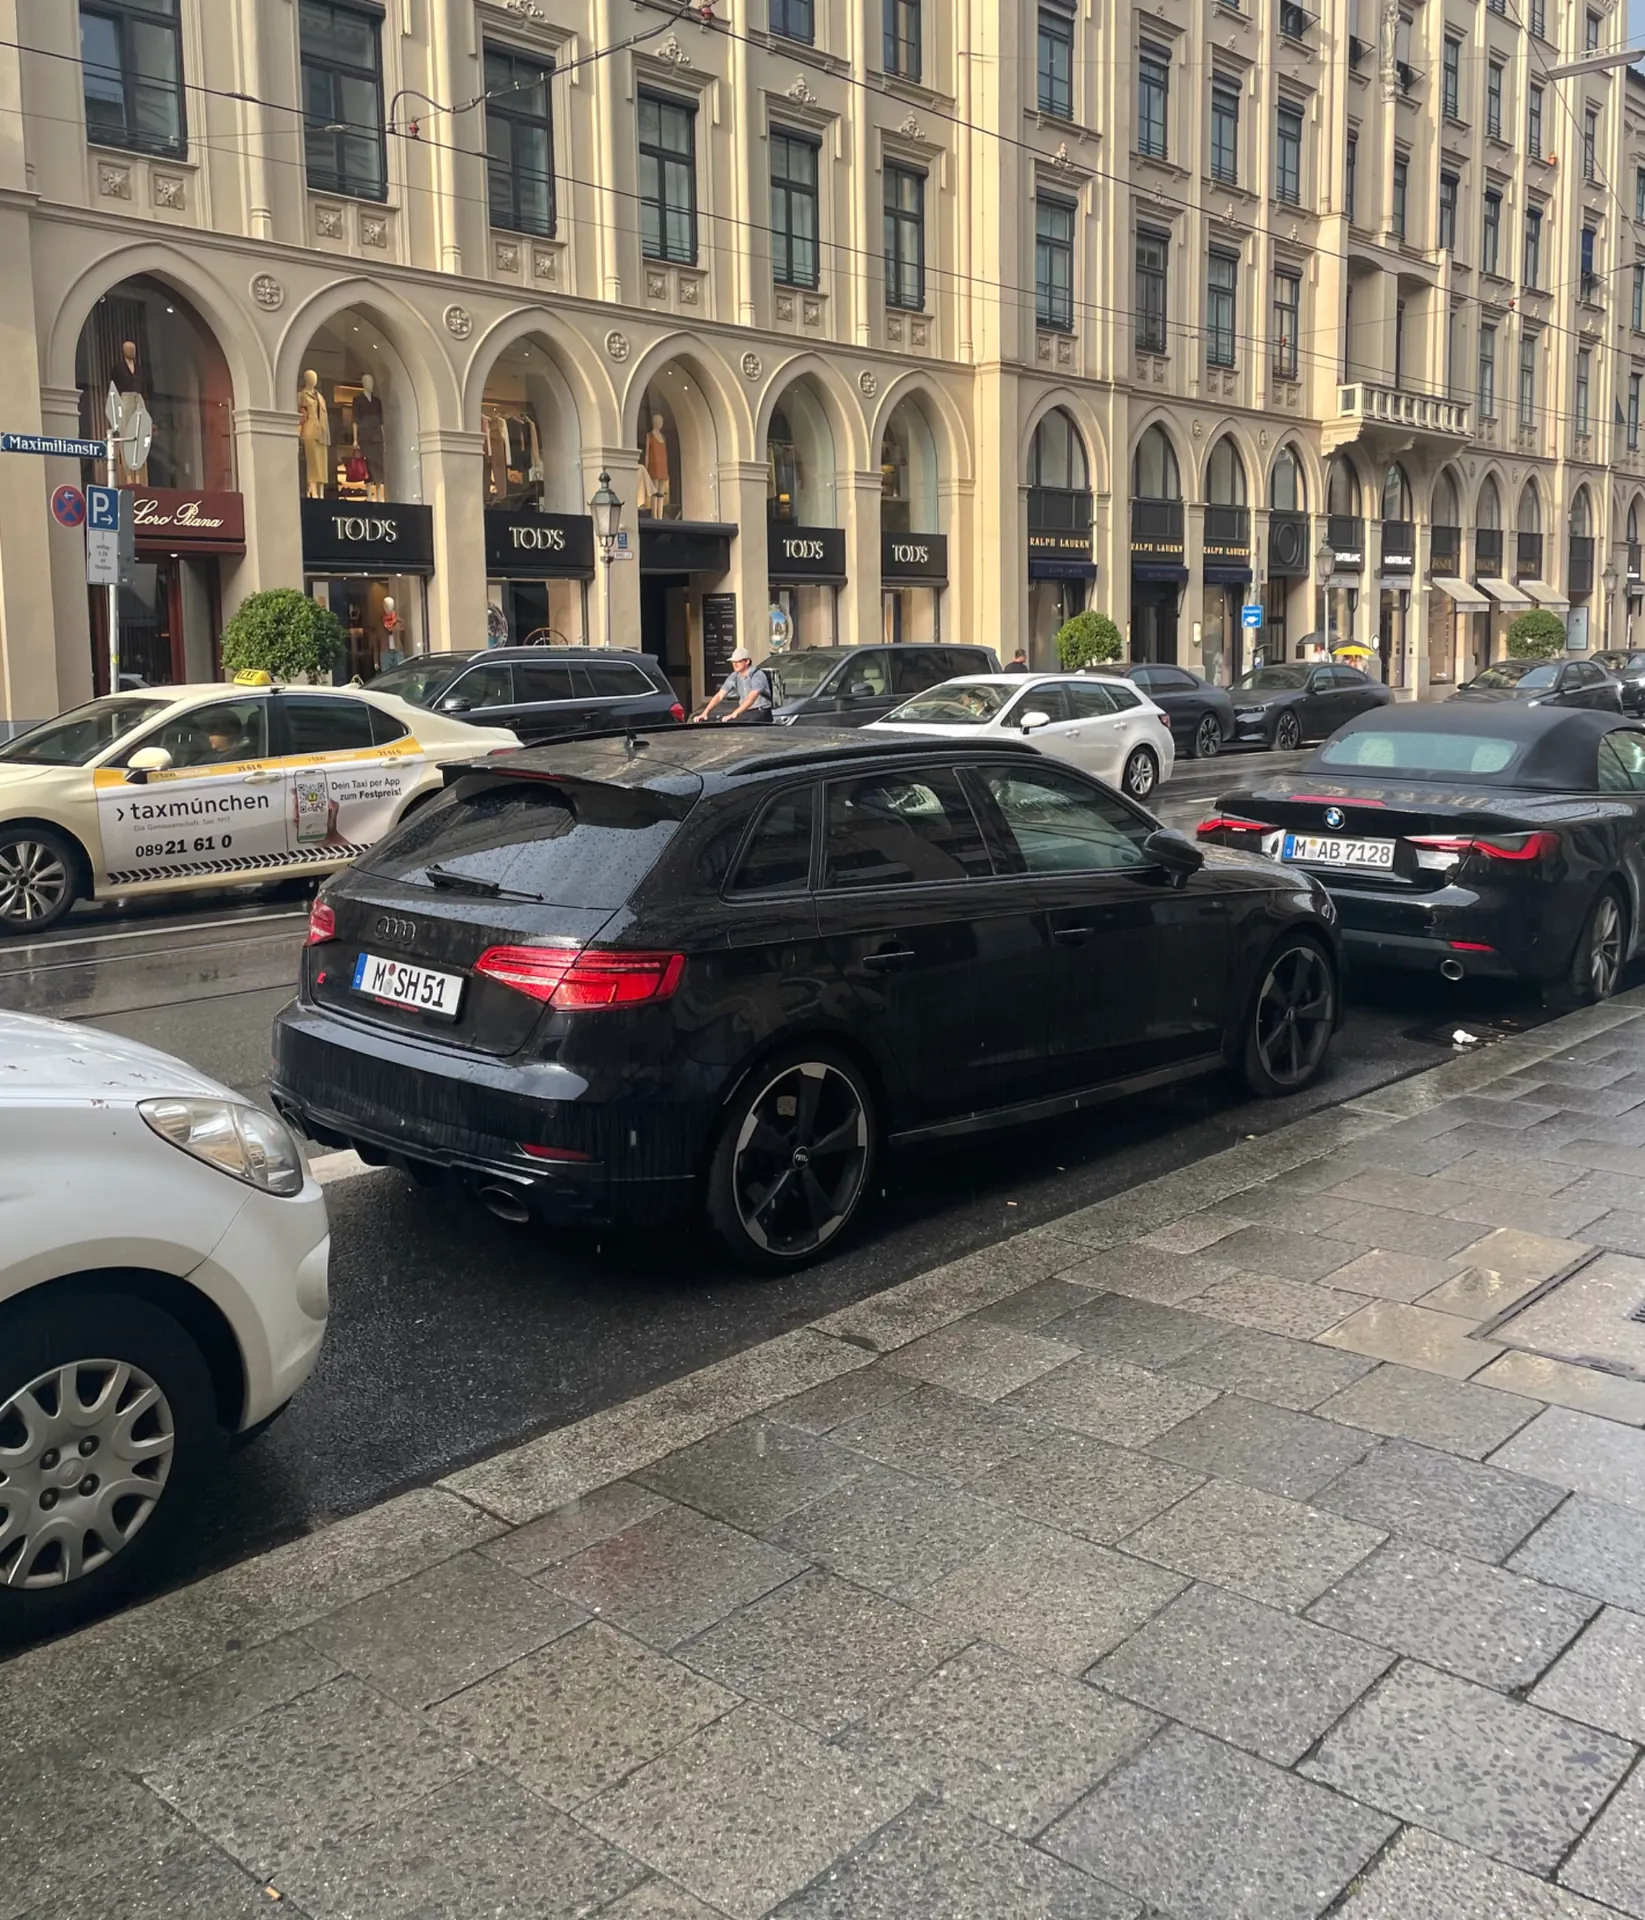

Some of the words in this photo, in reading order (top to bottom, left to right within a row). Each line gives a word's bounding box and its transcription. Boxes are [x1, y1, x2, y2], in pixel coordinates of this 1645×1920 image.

[9, 436, 103, 456] Maximilianstr.
[92, 492, 110, 523] P
[133, 499, 173, 525] Loro
[173, 500, 223, 528] Piana
[332, 516, 398, 543] TOD'S
[508, 526, 566, 550] TOD'S
[783, 539, 824, 560] TOD'S
[1030, 537, 1056, 547] RALPH
[1060, 538, 1090, 549] LAUREN
[1130, 543, 1153, 552] RALPH
[892, 544, 929, 563] TOD'S
[331, 781, 350, 791] Dein
[352, 780, 368, 790] Taxi
[369, 779, 382, 789] per
[384, 777, 401, 787] App
[340, 792, 357, 801] zum
[359, 788, 402, 799] Festpreis!
